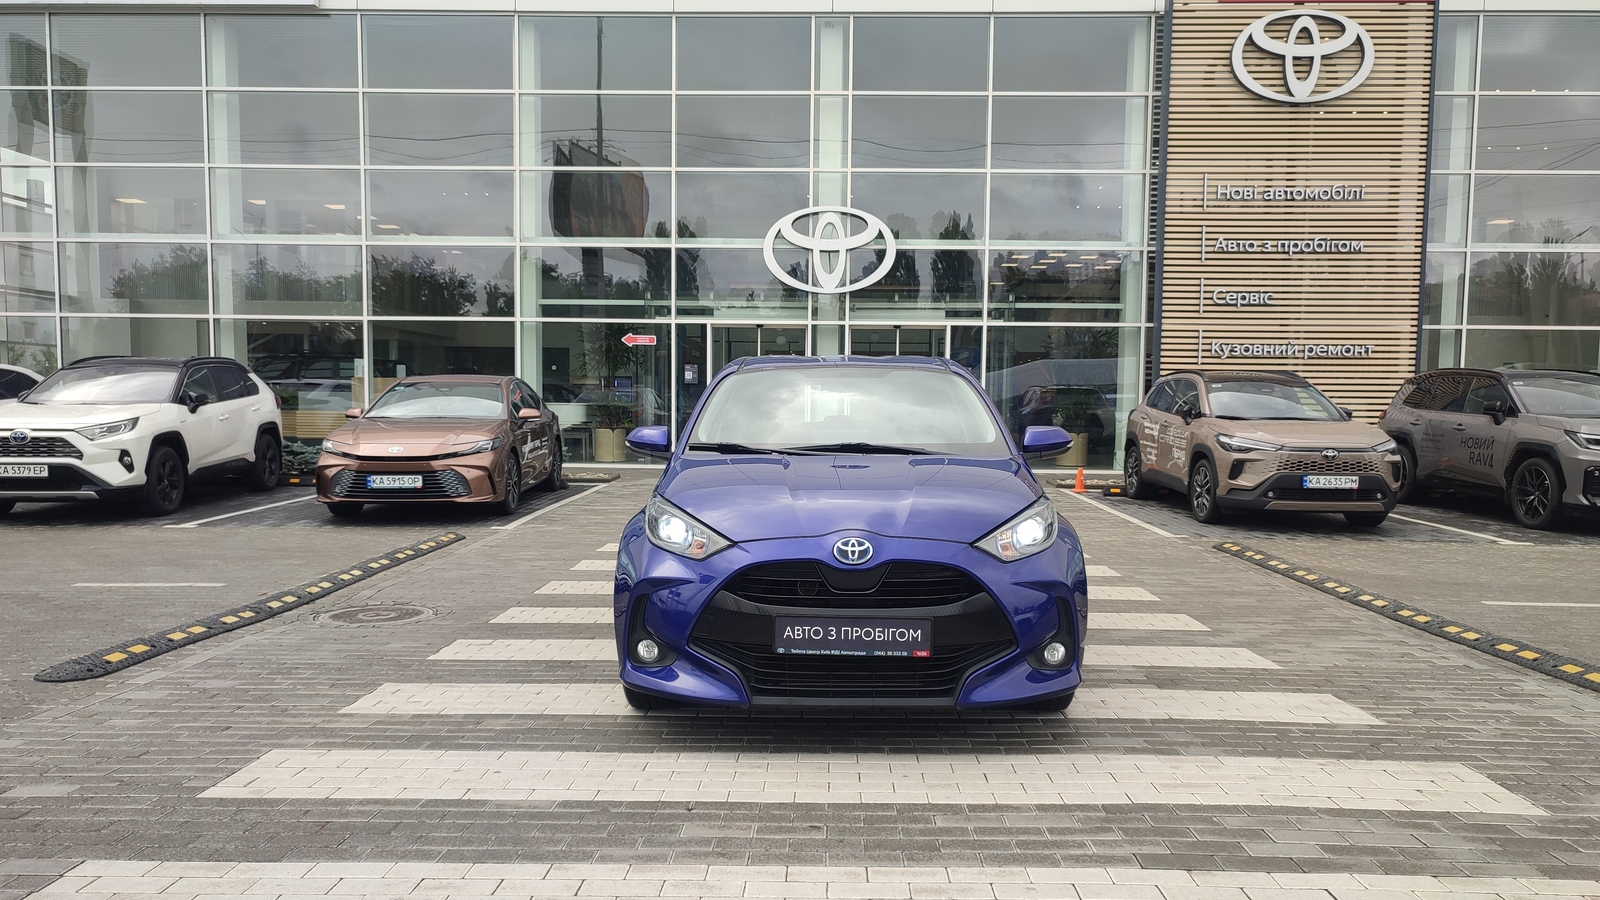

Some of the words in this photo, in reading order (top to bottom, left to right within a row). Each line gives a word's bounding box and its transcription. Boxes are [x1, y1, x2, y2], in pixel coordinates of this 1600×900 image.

[1216, 184, 1258, 201] Нові
[1263, 184, 1366, 201] автомобілі
[1213, 236, 1257, 253] Авто
[1261, 240, 1271, 254] з
[1277, 236, 1364, 256] пробігом
[1212, 289, 1275, 308] Сервіс
[1210, 340, 1298, 360] Кузовний
[1303, 344, 1375, 360] ремонт
[1159, 433, 1187, 448] CROSS
[1460, 435, 1495, 451] НОВИЙ
[1469, 451, 1494, 469] RAV4
[11, 466, 32, 475] 5379
[33, 466, 46, 475] EP
[372, 477, 385, 485] KA
[386, 477, 406, 485] 5915
[407, 477, 420, 485] OP
[1308, 477, 1321, 486] KA
[1322, 477, 1343, 486] 2635
[1344, 477, 1358, 486] PM
[783, 626, 824, 640] АВТО
[827, 626, 837, 640] З
[841, 627, 922, 642] ПРОБІГОМ
